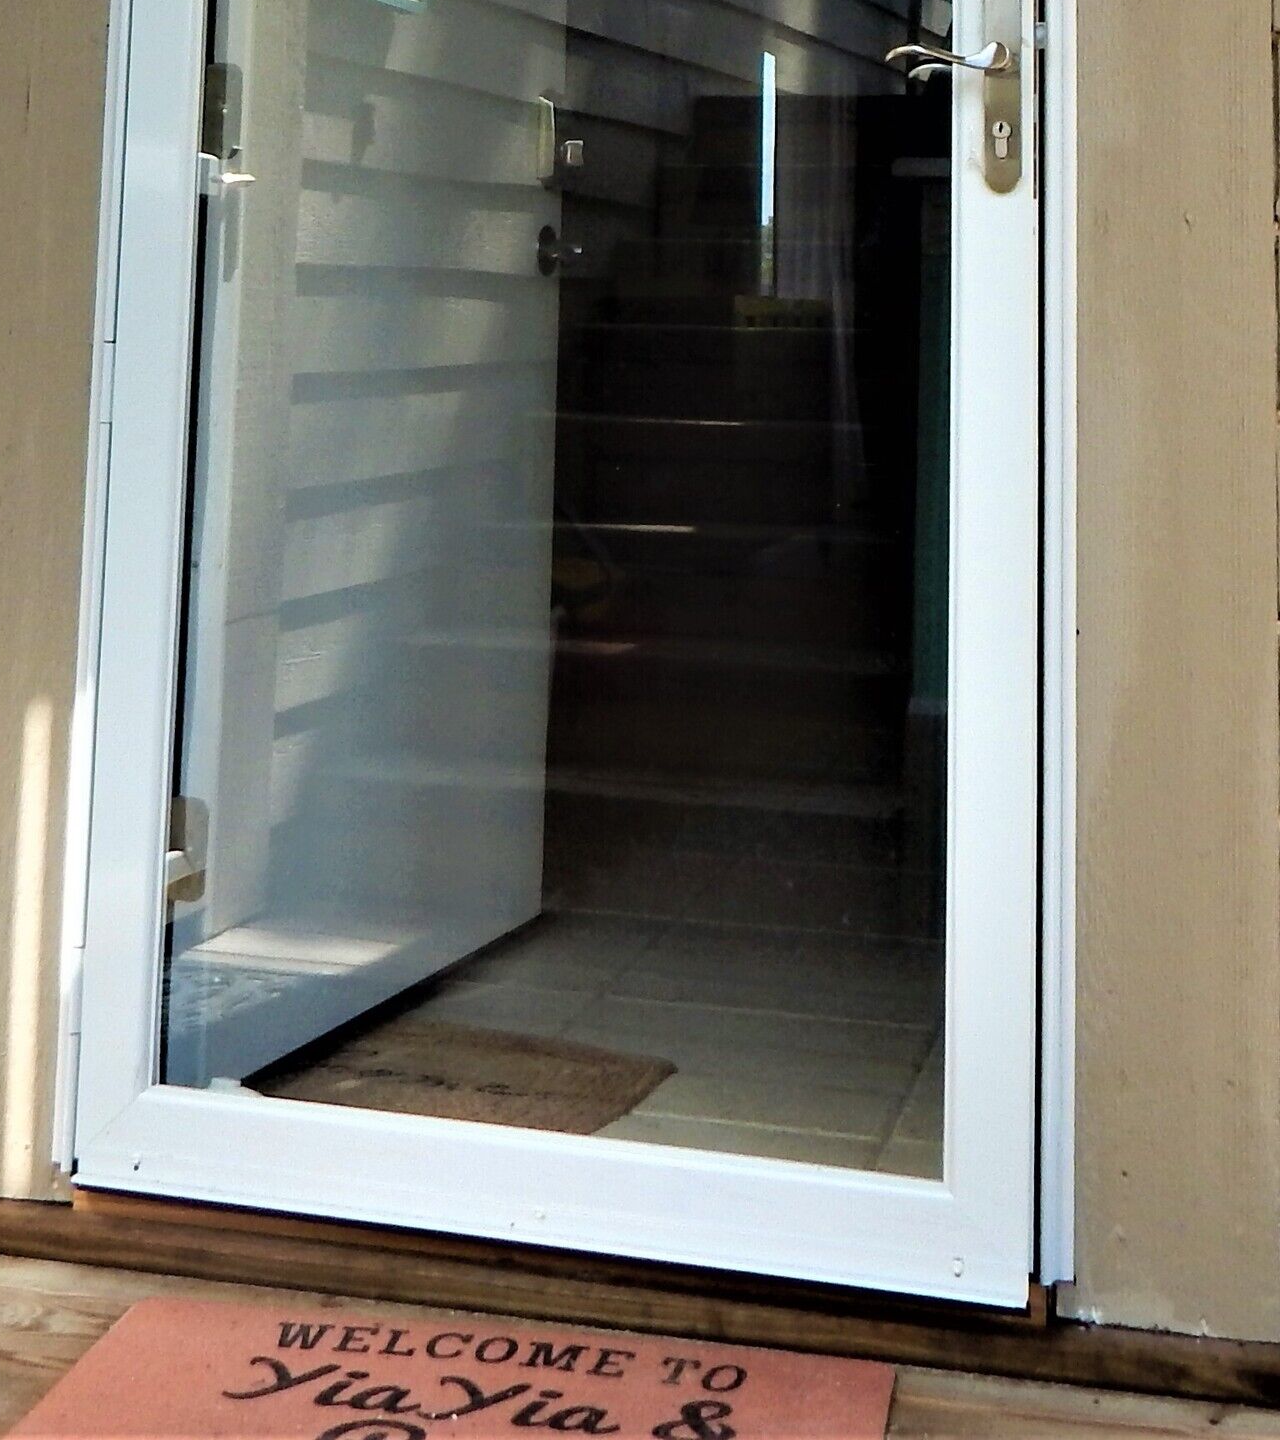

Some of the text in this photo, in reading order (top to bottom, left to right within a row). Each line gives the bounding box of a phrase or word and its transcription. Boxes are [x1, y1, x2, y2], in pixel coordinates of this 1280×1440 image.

[276, 1321, 748, 1392] WELCOME TO
[651, 1399, 737, 1440] &
